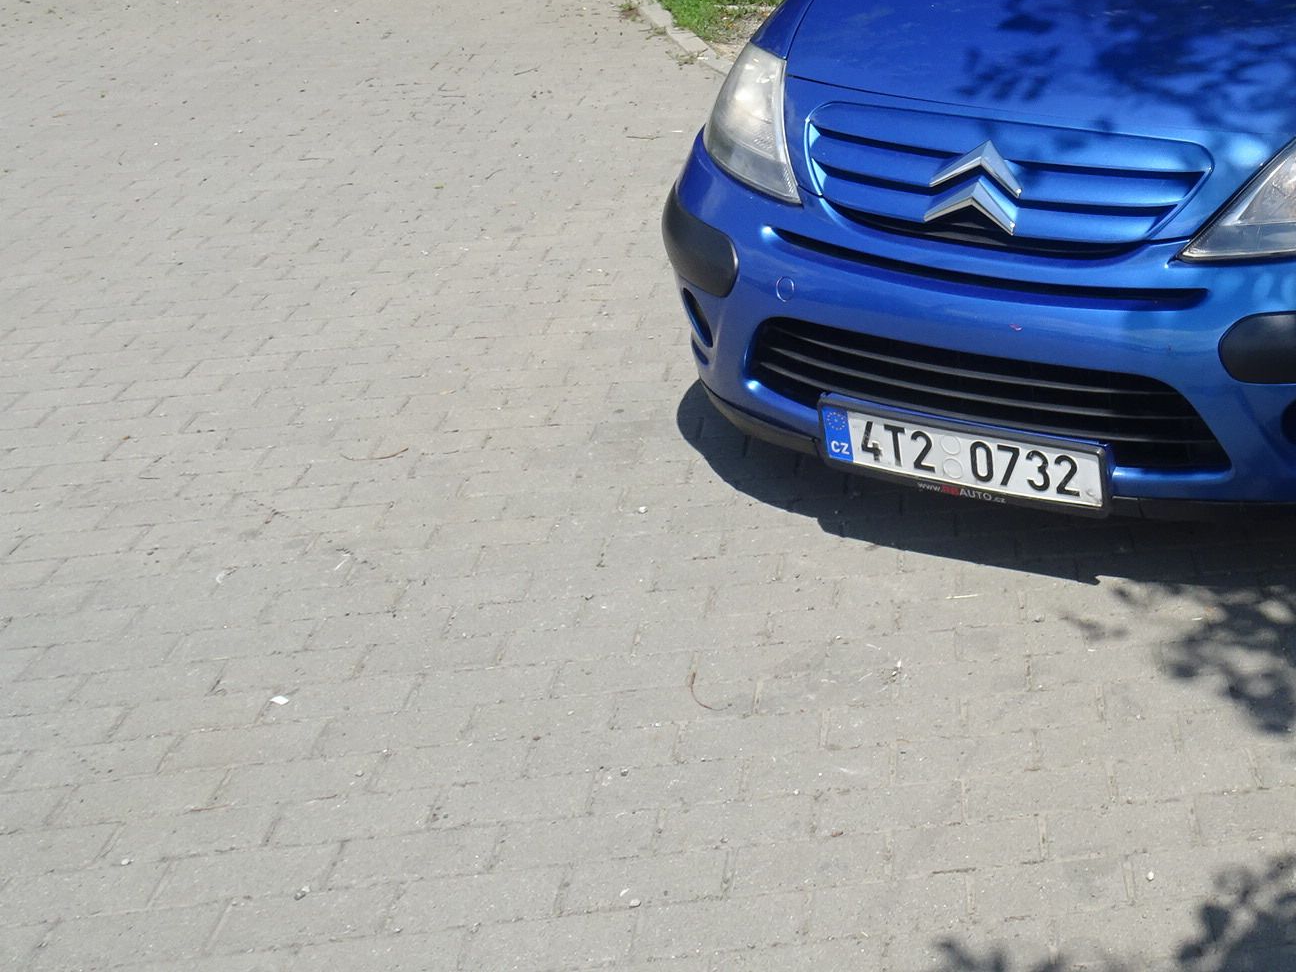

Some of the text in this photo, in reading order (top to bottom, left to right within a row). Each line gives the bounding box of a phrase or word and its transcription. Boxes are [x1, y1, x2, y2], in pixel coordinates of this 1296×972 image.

[831, 440, 850, 456] CZ
[860, 420, 1081, 498] 4T2 0732
